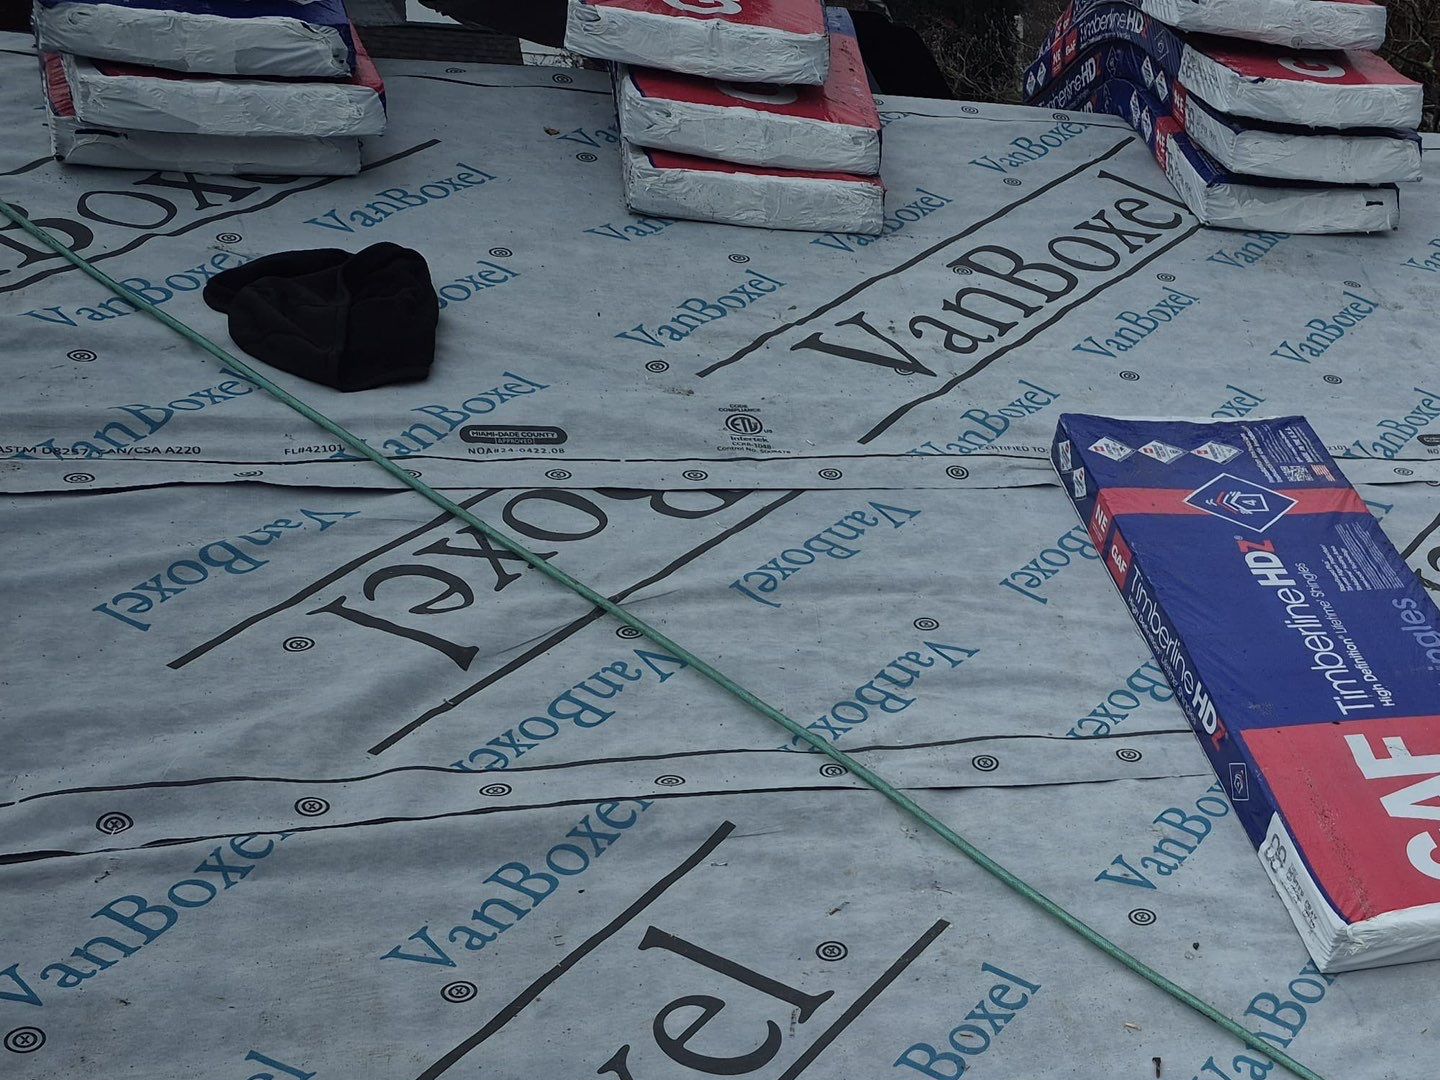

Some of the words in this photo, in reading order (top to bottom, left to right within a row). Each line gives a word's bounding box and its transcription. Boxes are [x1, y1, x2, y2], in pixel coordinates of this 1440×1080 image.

[304, 162, 497, 238] VanBoxel
[615, 270, 787, 351] VanBoxel
[789, 170, 1197, 378] VanBoxel
[1073, 286, 1200, 362] VanBoxel
[1271, 291, 1379, 366] VanBoxel
[165, 446, 202, 455] A220
[471, 429, 520, 439] MIAMI-DADE
[520, 431, 556, 439] COUNTY
[729, 501, 922, 608] VanBoxel
[1094, 503, 1109, 531] NE
[93, 508, 361, 631] VanBoxel
[1111, 544, 1129, 575] GAF
[1296, 561, 1323, 598] Shingles
[1128, 563, 1194, 696] Timberline
[1276, 586, 1376, 717] Timberline
[1369, 681, 1396, 708] High
